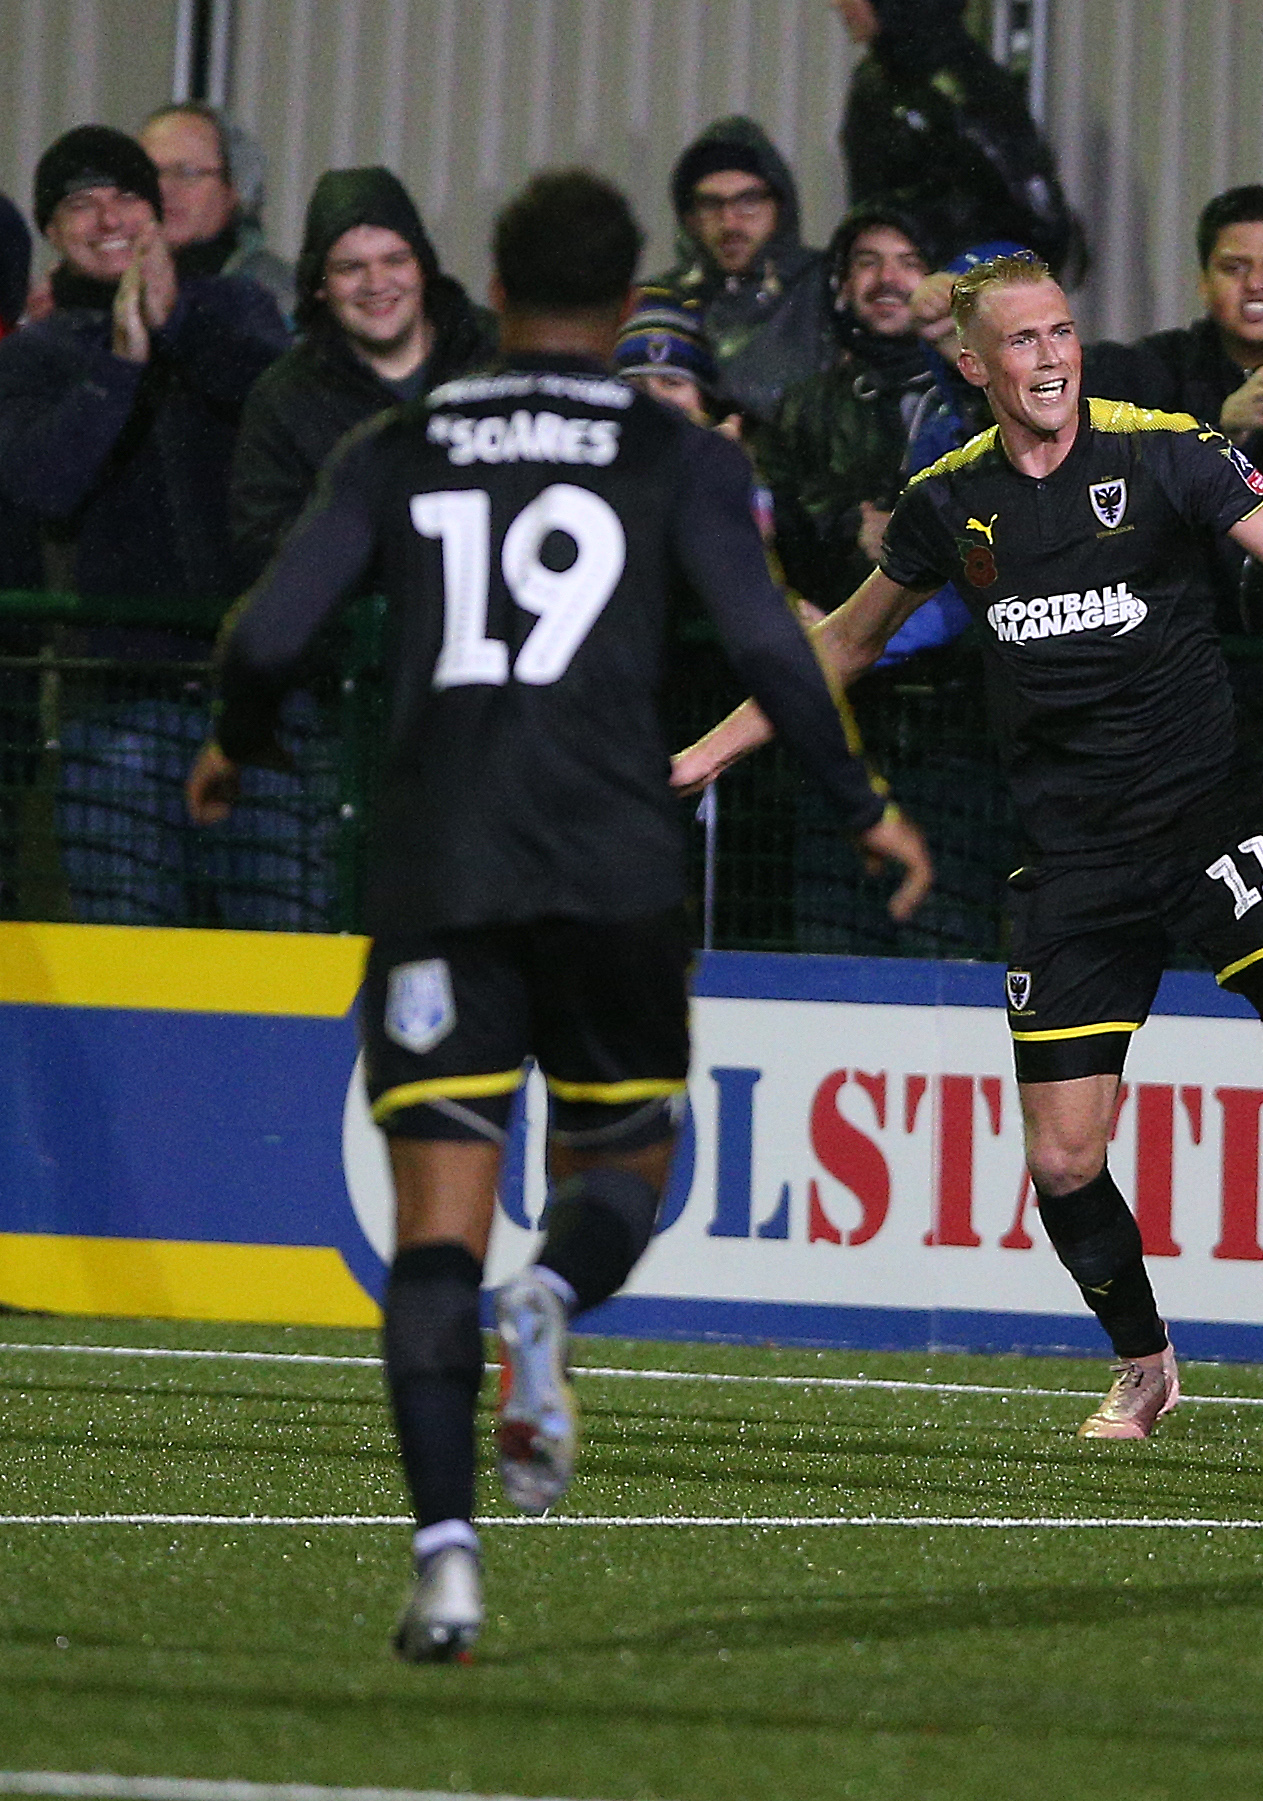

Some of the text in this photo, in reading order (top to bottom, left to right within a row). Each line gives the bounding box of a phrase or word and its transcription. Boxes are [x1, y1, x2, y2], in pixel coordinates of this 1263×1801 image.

[448, 409, 623, 468] SOARES
[409, 482, 627, 692] 19
[993, 582, 1134, 623] FOOTBALL
[997, 600, 1142, 643] MANAGER
